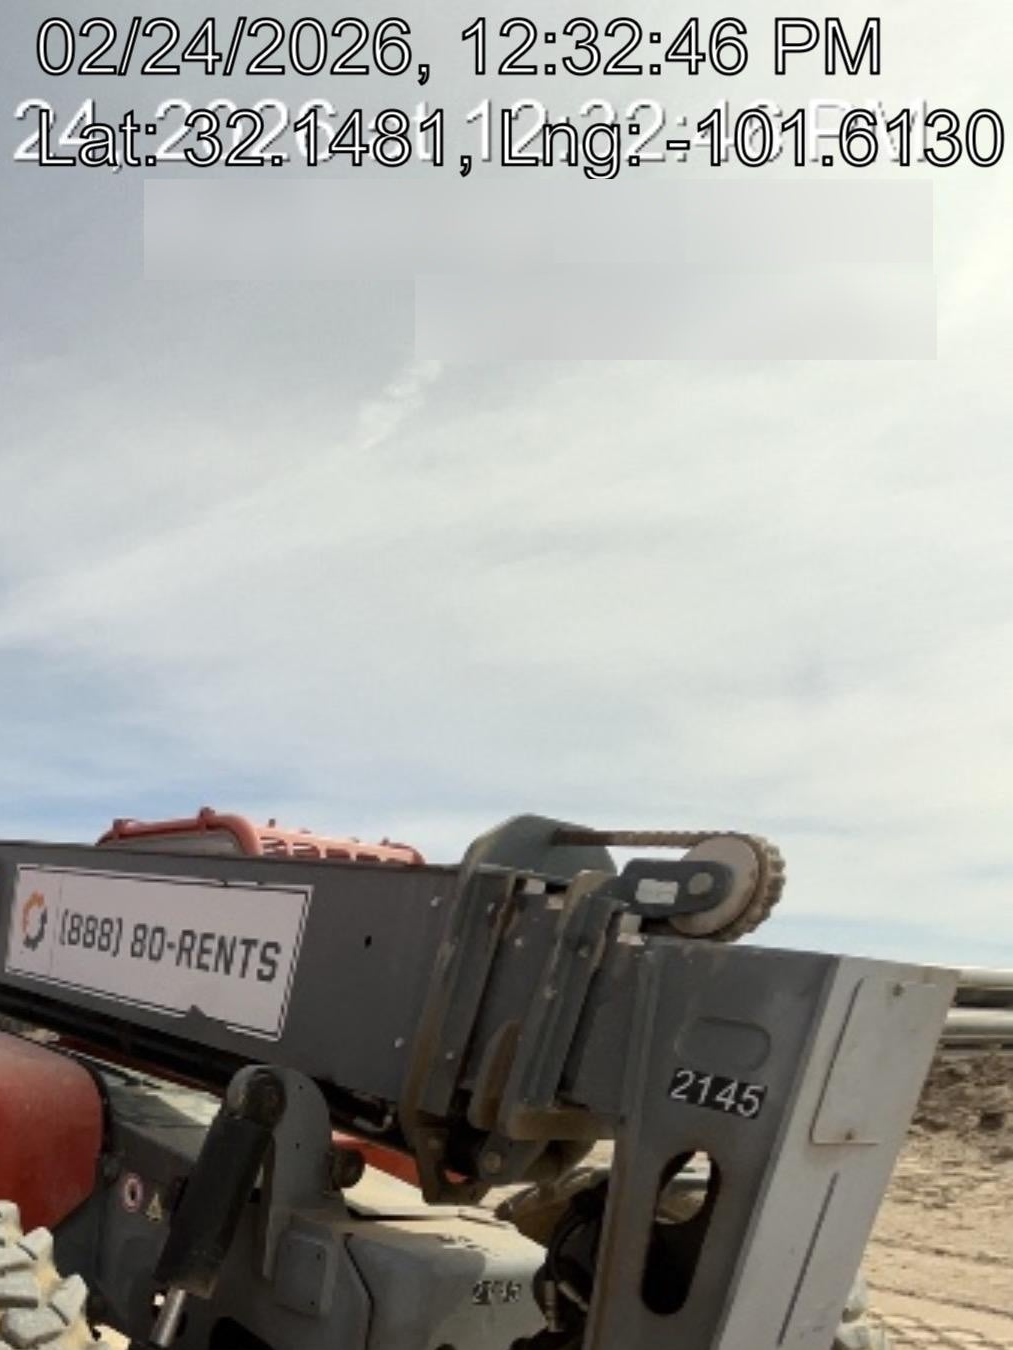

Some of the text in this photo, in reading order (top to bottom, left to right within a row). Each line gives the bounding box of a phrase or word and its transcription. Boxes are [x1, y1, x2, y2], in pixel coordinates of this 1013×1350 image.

[59, 908, 283, 983] (888) 80-RENTS
[670, 1069, 764, 1117] 2145
